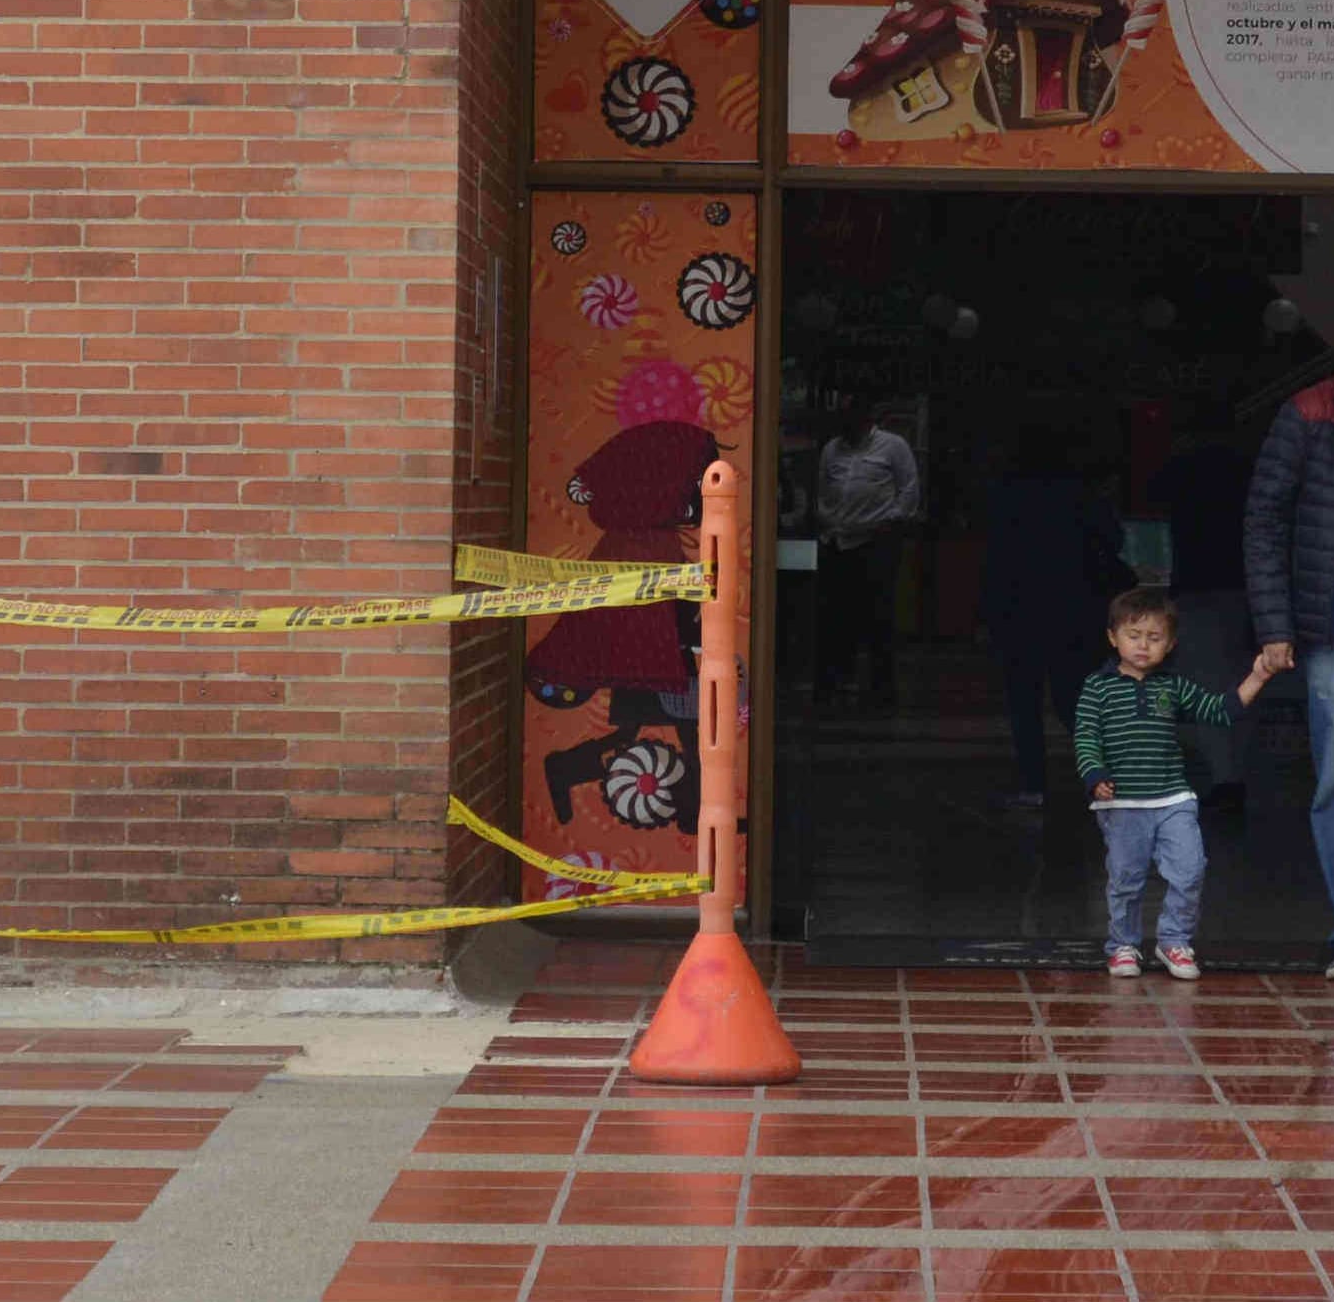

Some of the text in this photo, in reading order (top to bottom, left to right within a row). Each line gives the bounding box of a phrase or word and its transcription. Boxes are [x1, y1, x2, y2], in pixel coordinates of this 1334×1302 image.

[1227, 18, 1284, 29] octubre
[1288, 20, 1297, 31] y
[1300, 18, 1313, 29] el
[483, 583, 610, 606] PELIGRO NO PASE
